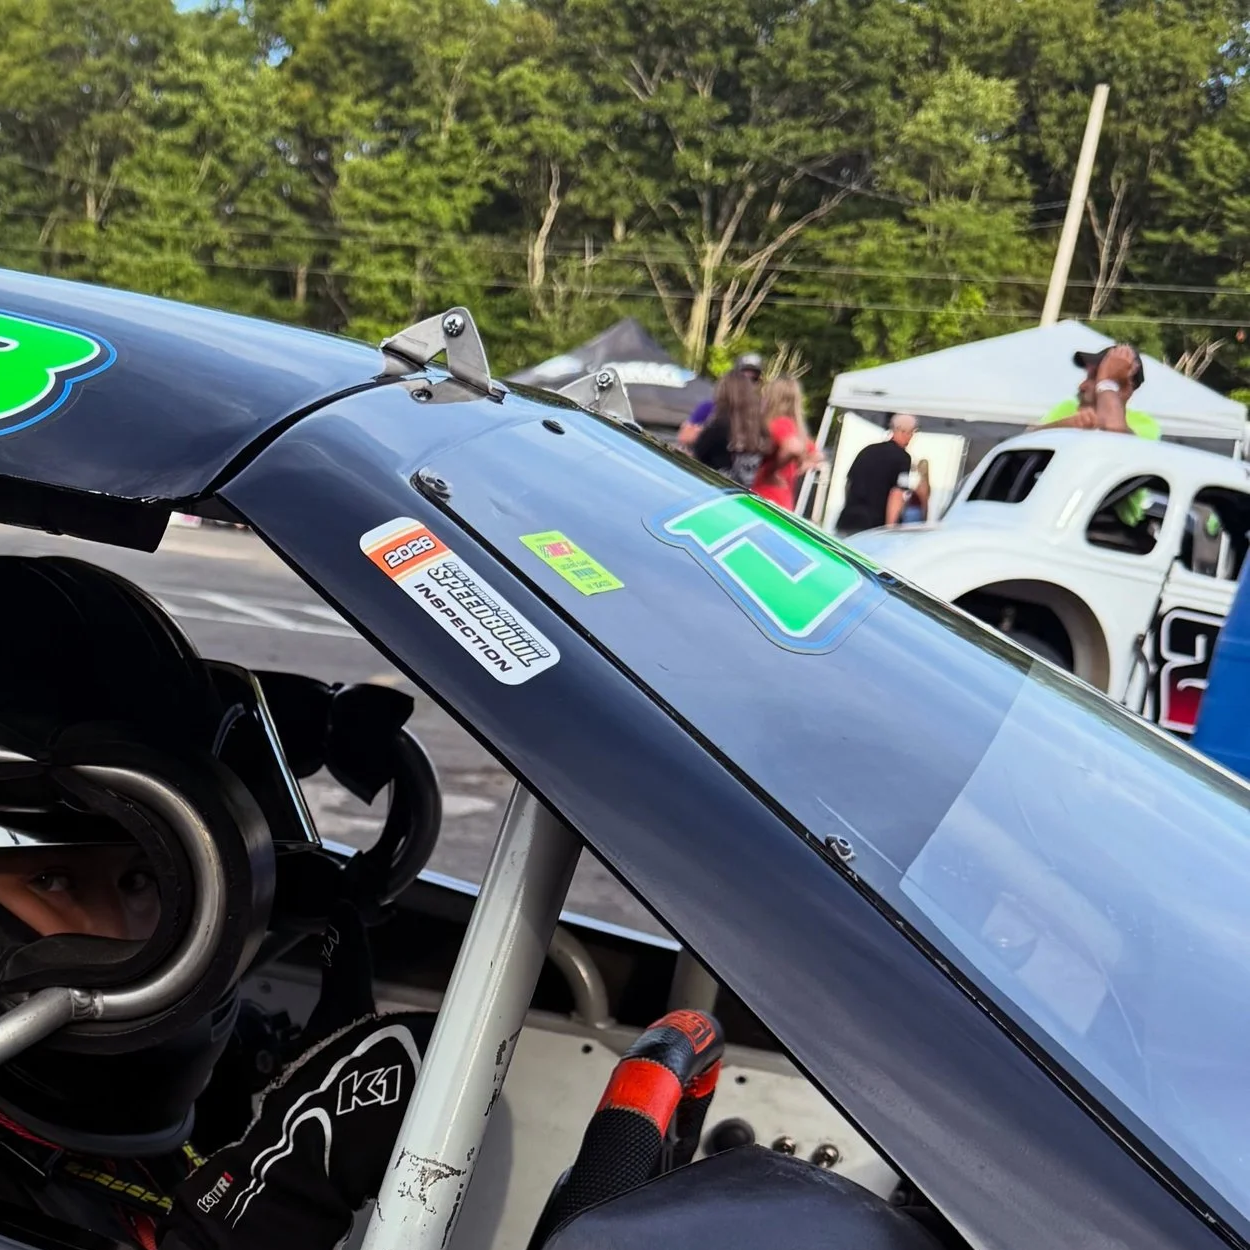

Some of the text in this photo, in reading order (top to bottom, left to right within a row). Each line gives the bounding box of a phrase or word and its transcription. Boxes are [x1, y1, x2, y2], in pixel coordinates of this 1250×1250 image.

[382, 535, 437, 570] 2026
[413, 582, 513, 673] INSPECTION
[426, 566, 542, 668] SPEEDBOWL
[335, 1064, 402, 1116] K1
